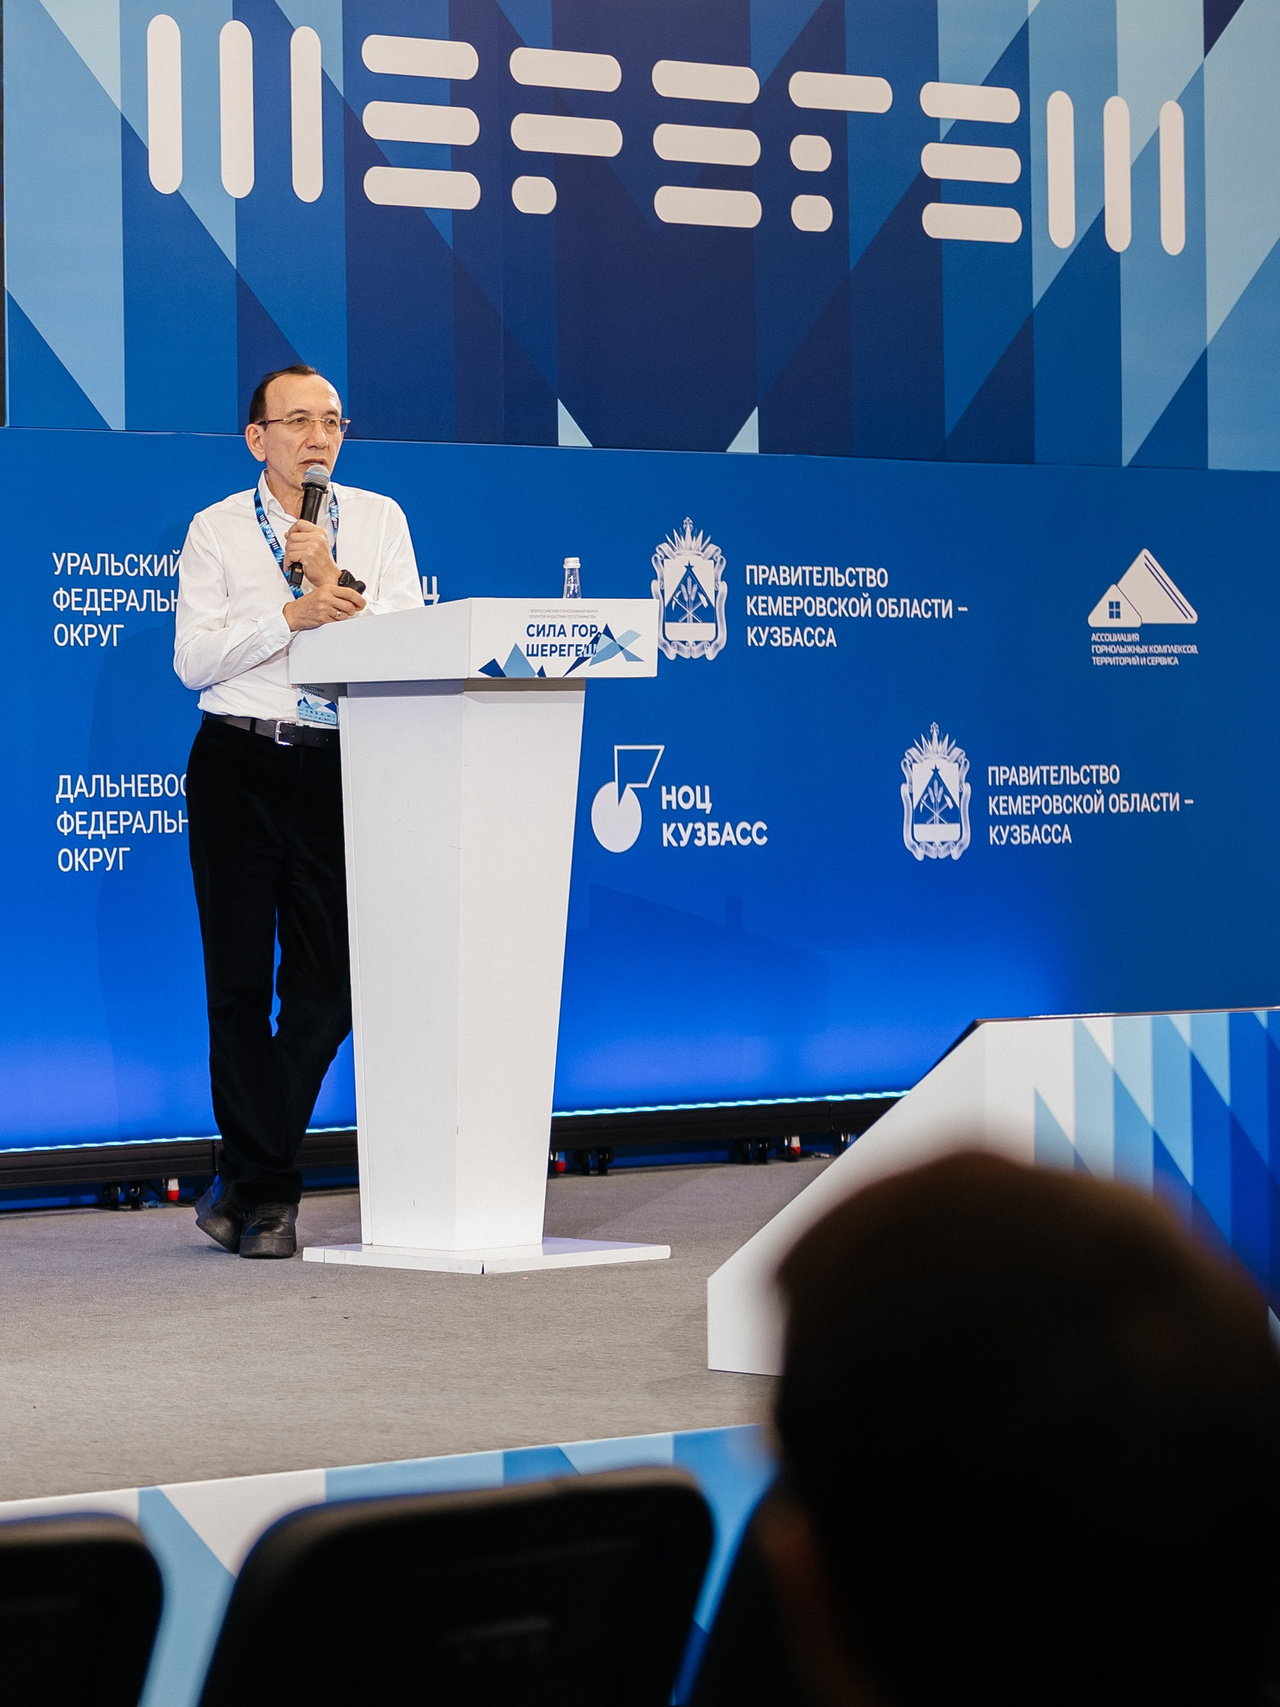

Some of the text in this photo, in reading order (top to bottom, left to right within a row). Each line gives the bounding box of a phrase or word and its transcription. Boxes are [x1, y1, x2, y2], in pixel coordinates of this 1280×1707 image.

[52, 549, 180, 577] УРАЛЬСКИЙ
[746, 564, 889, 588] ПРАВИТЕЛЬСТВО
[52, 587, 177, 616] ФЕДЕРАЛЬН
[746, 592, 872, 618] КЕМЕРОВСКОЙ
[876, 597, 953, 619] ОБЛАСТИ
[53, 623, 125, 647] ОКРУГ
[526, 624, 599, 638] СИЛА ГОР
[747, 626, 837, 648] КУЗБАССА
[1090, 632, 1140, 643] АССОЦИАЦИЯ
[1092, 655, 1140, 666] ТЕРРИТОРИЙ
[1147, 656, 1179, 666] СЕРВИСА
[988, 764, 1120, 787] ПРАВИТЕЛЬСТВО
[55, 773, 187, 804] ДАЛЬНЕВО
[661, 785, 713, 814] НОЦ
[988, 789, 1105, 817] КЕМЕРОВСКОЙ
[1108, 792, 1180, 813] ОБЛАСТИ
[56, 810, 189, 840] ФЕДЕРАЛЬН
[662, 821, 769, 848] КУЗБАСС
[989, 824, 1072, 846] КУЗБАССА
[57, 847, 131, 872] ОКРУГ
